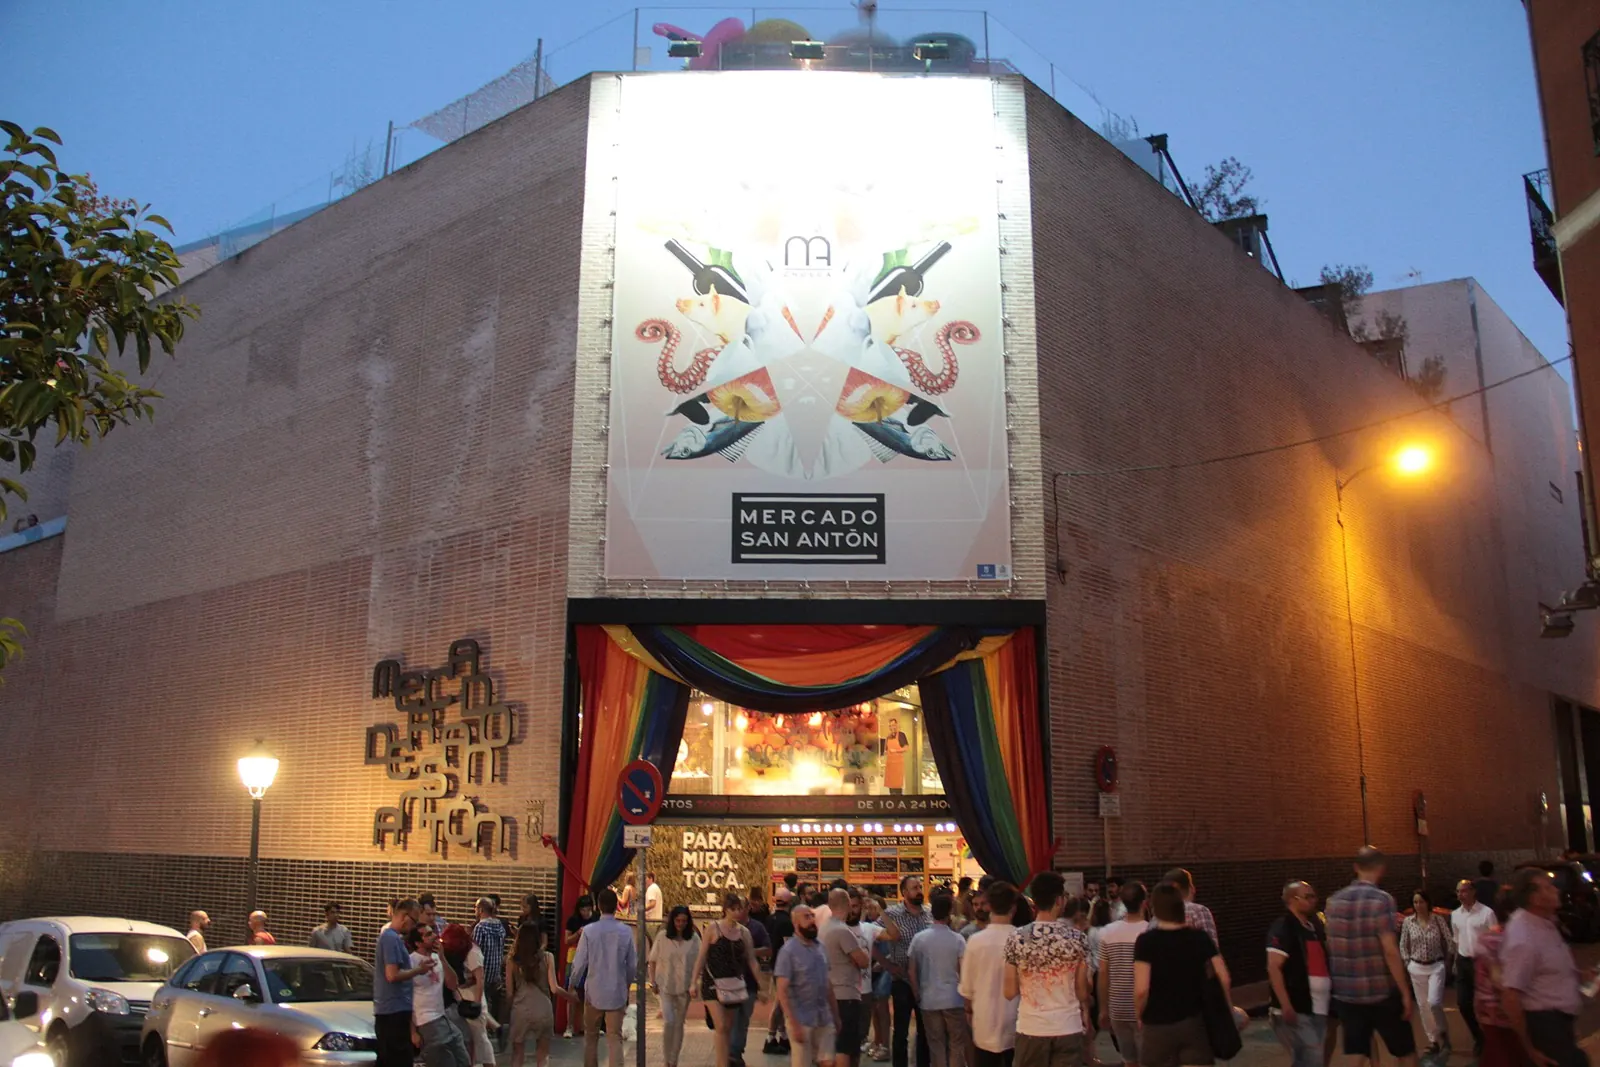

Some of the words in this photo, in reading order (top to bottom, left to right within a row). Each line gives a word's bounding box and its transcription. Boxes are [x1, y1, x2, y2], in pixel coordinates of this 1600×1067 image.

[740, 509, 877, 525] MERCADO
[741, 531, 789, 547] SAN
[662, 800, 693, 809] RTOS
[857, 800, 874, 809] DE
[879, 800, 895, 809] 10
[897, 800, 907, 809] A
[910, 800, 927, 809] 24
[930, 800, 950, 809] HO
[682, 832, 742, 849] PARA.
[682, 851, 739, 869] MIRA.
[682, 871, 745, 889] TOCA.
